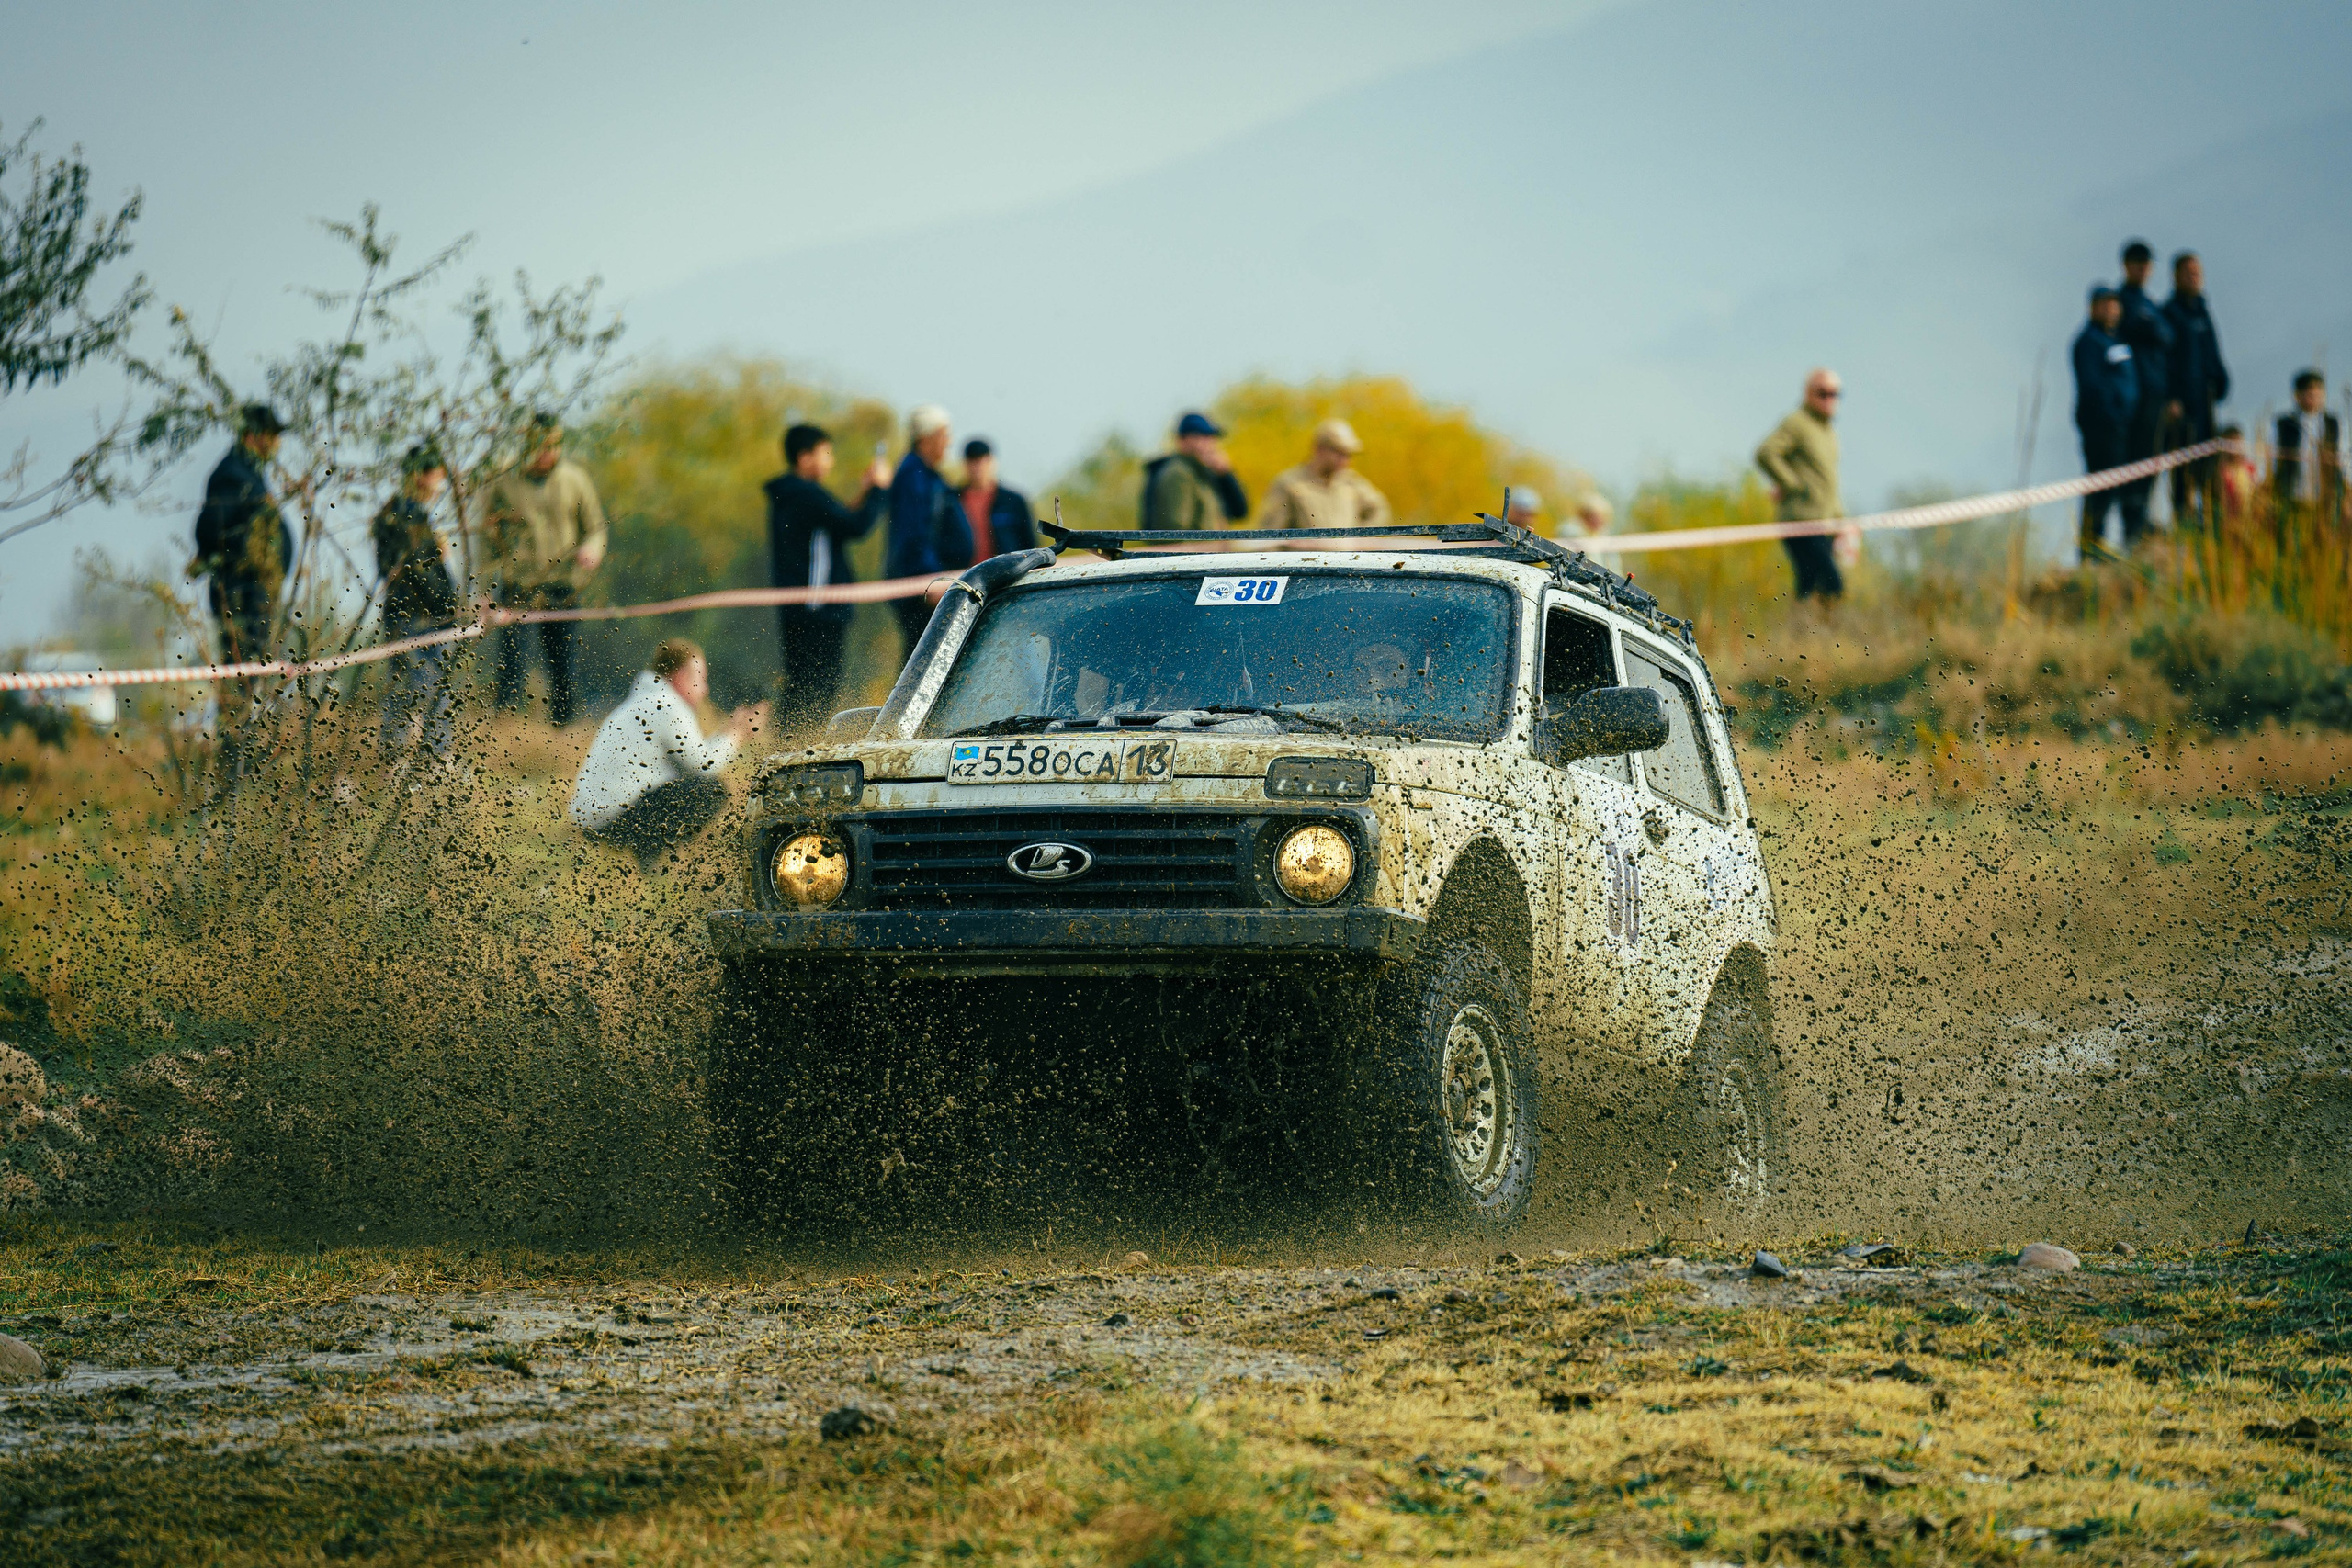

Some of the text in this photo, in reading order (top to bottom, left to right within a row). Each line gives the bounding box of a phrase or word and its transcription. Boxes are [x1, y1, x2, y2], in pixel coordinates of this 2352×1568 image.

[1234, 580, 1278, 601] 30
[951, 763, 977, 777] KZ
[1125, 744, 1170, 776] 13
